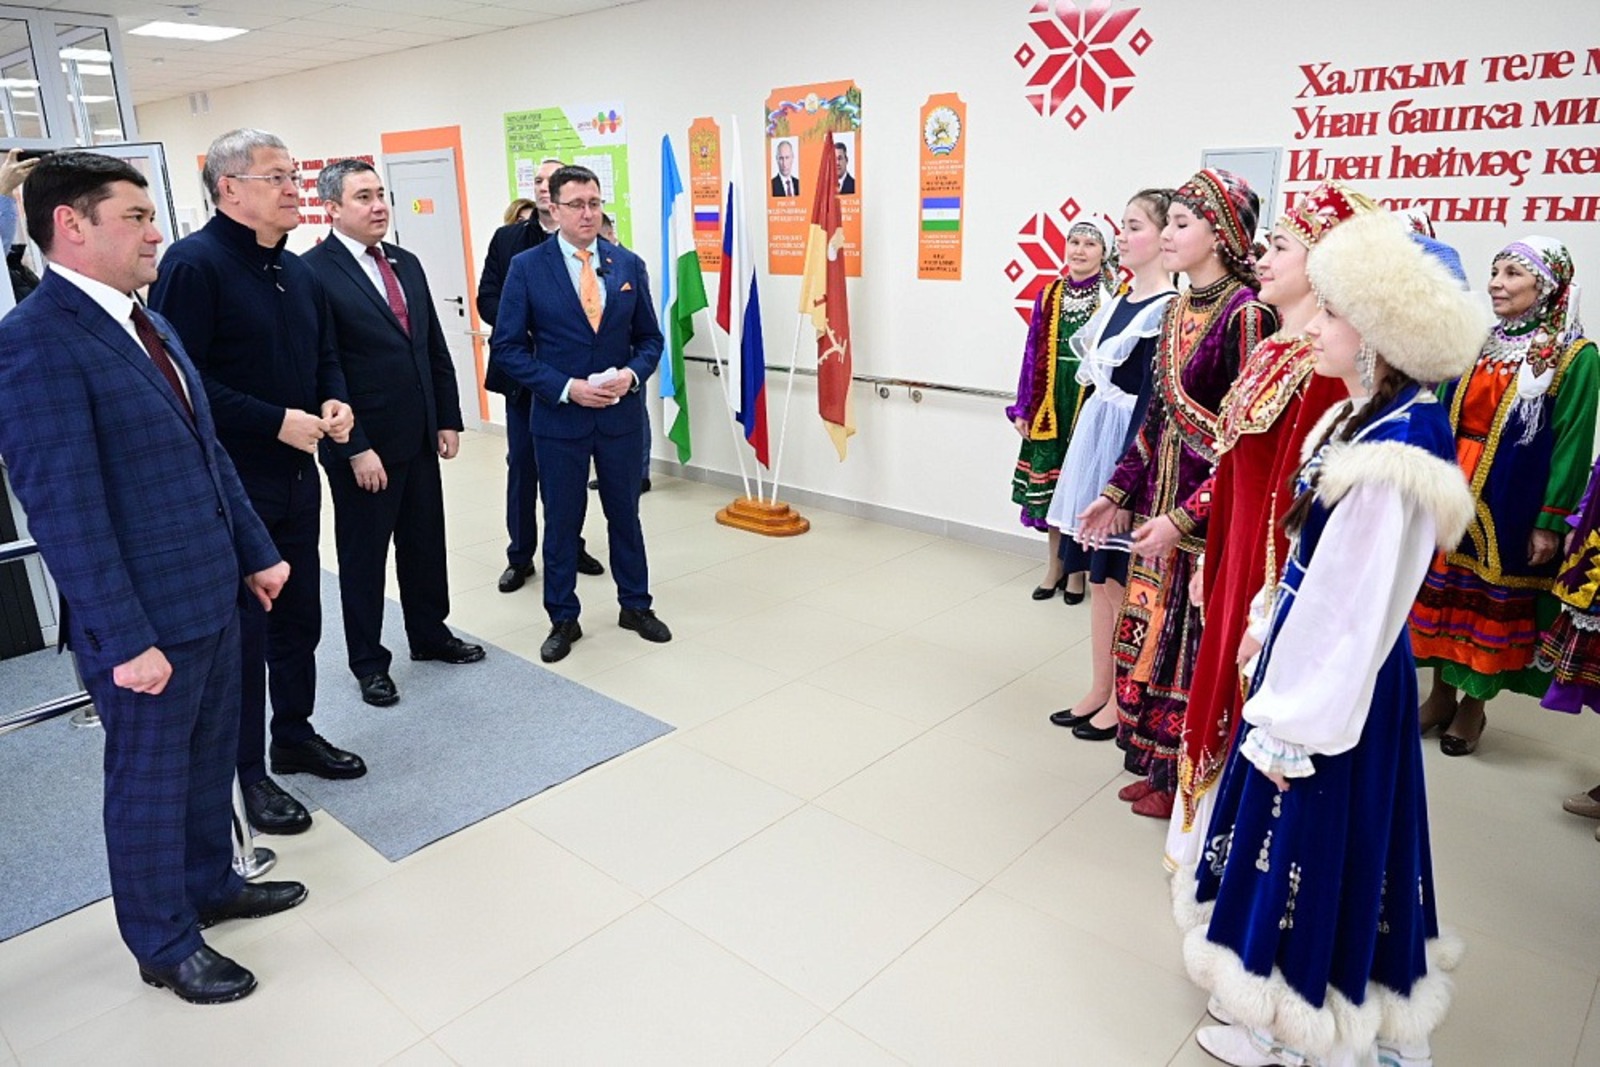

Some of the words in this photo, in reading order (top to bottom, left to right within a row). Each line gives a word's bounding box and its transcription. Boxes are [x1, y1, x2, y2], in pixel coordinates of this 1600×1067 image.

[1481, 49, 1576, 82] теле
[1292, 105, 1381, 139] Унан
[1285, 149, 1382, 182] Илен
[1542, 147, 1600, 174] ке
